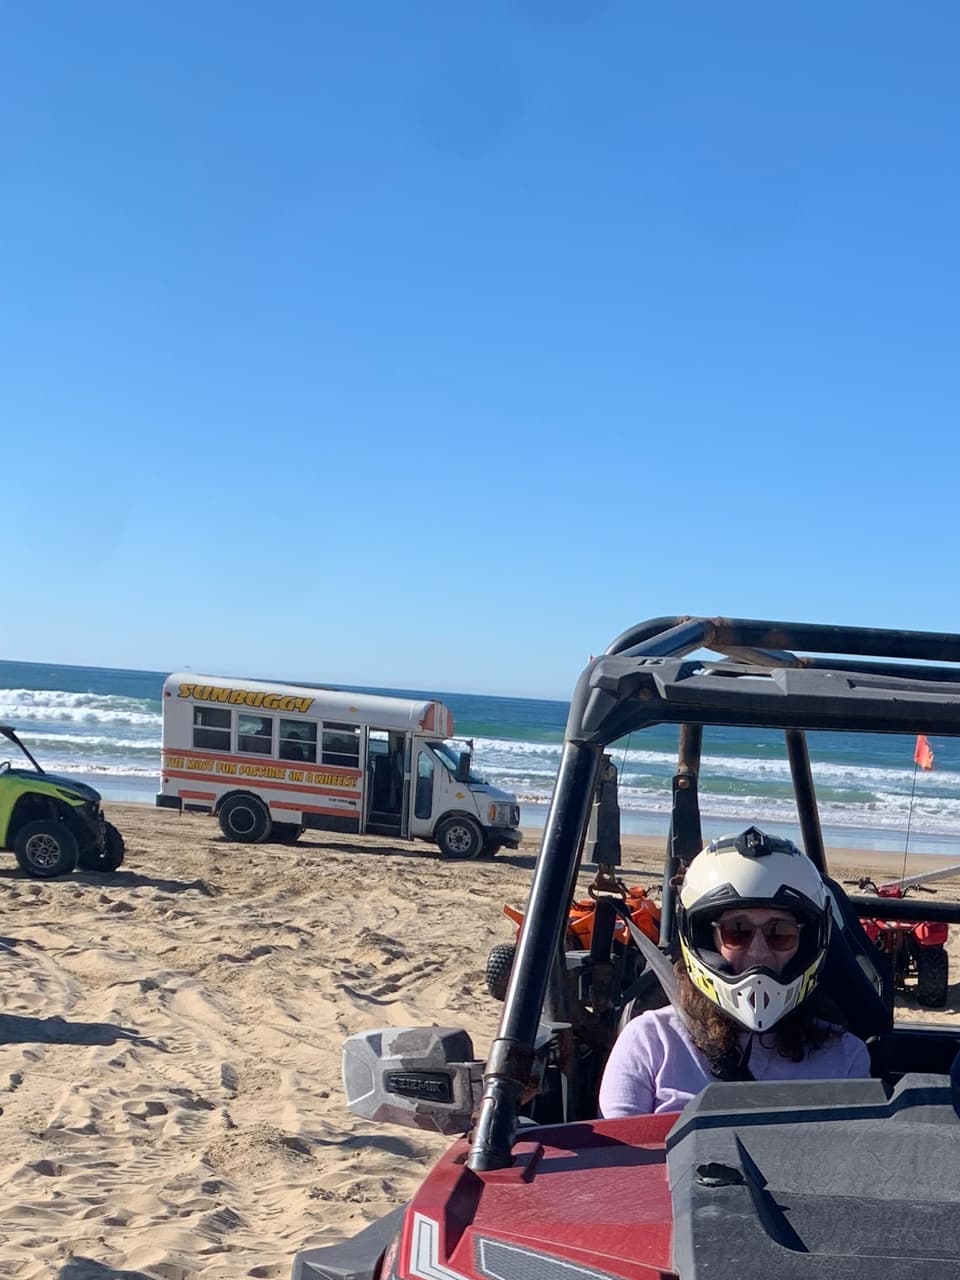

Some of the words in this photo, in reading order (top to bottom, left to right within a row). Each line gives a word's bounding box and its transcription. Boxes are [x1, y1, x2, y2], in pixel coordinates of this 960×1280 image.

[178, 684, 316, 714] SUNBUGGY
[187, 758, 213, 773] MOST
[216, 761, 237, 775] FUN
[239, 764, 286, 780] POSSIBLE
[288, 770, 304, 782] ON
